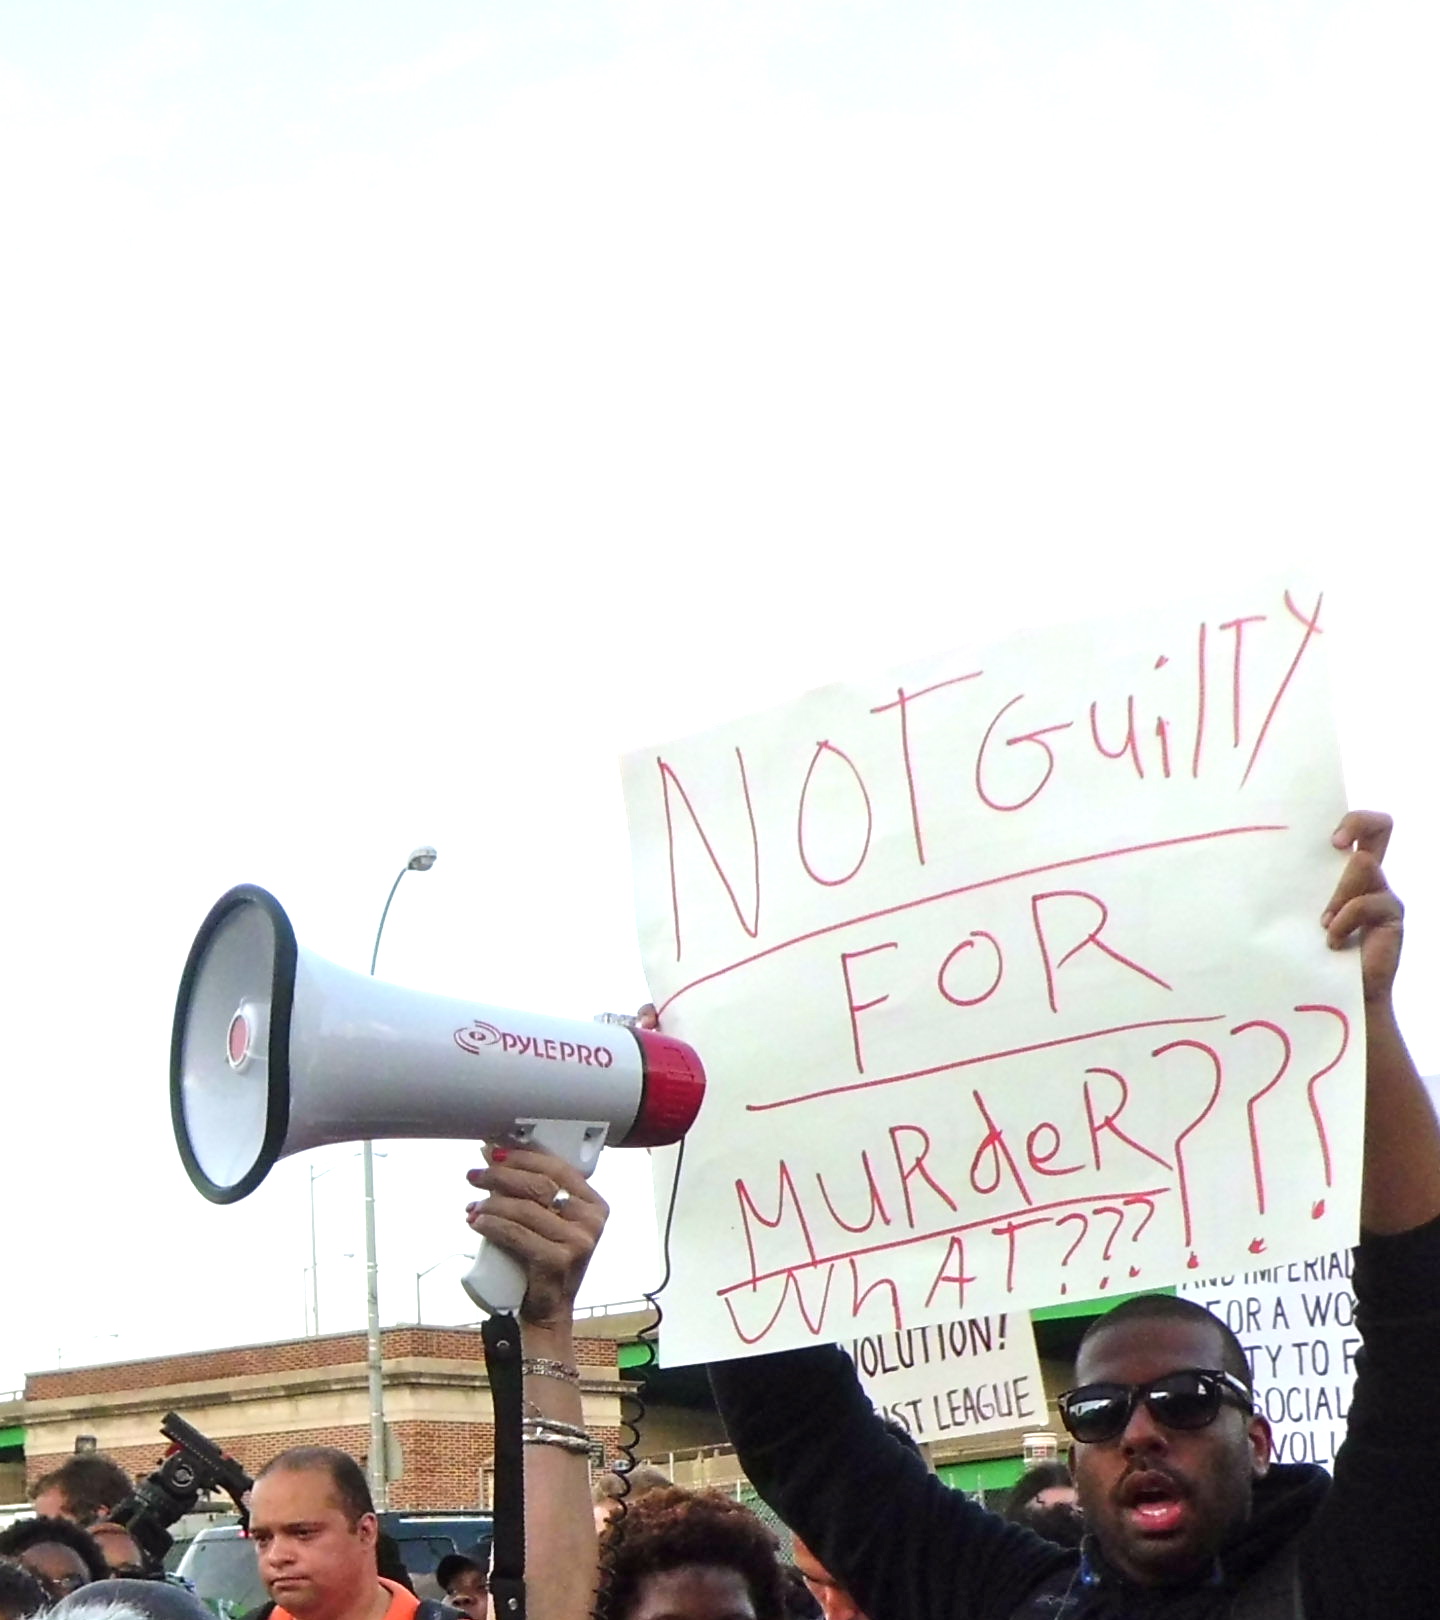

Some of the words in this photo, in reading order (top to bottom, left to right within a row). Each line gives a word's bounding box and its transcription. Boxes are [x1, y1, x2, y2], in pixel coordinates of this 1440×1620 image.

[657, 669, 985, 962] NOT
[840, 889, 1174, 1075] FOR
[500, 1031, 614, 1069] PYLEPRO
[1271, 1296, 1290, 1330] A
[1291, 1339, 1331, 1377] TO
[932, 1375, 1035, 1431] LEAGUE
